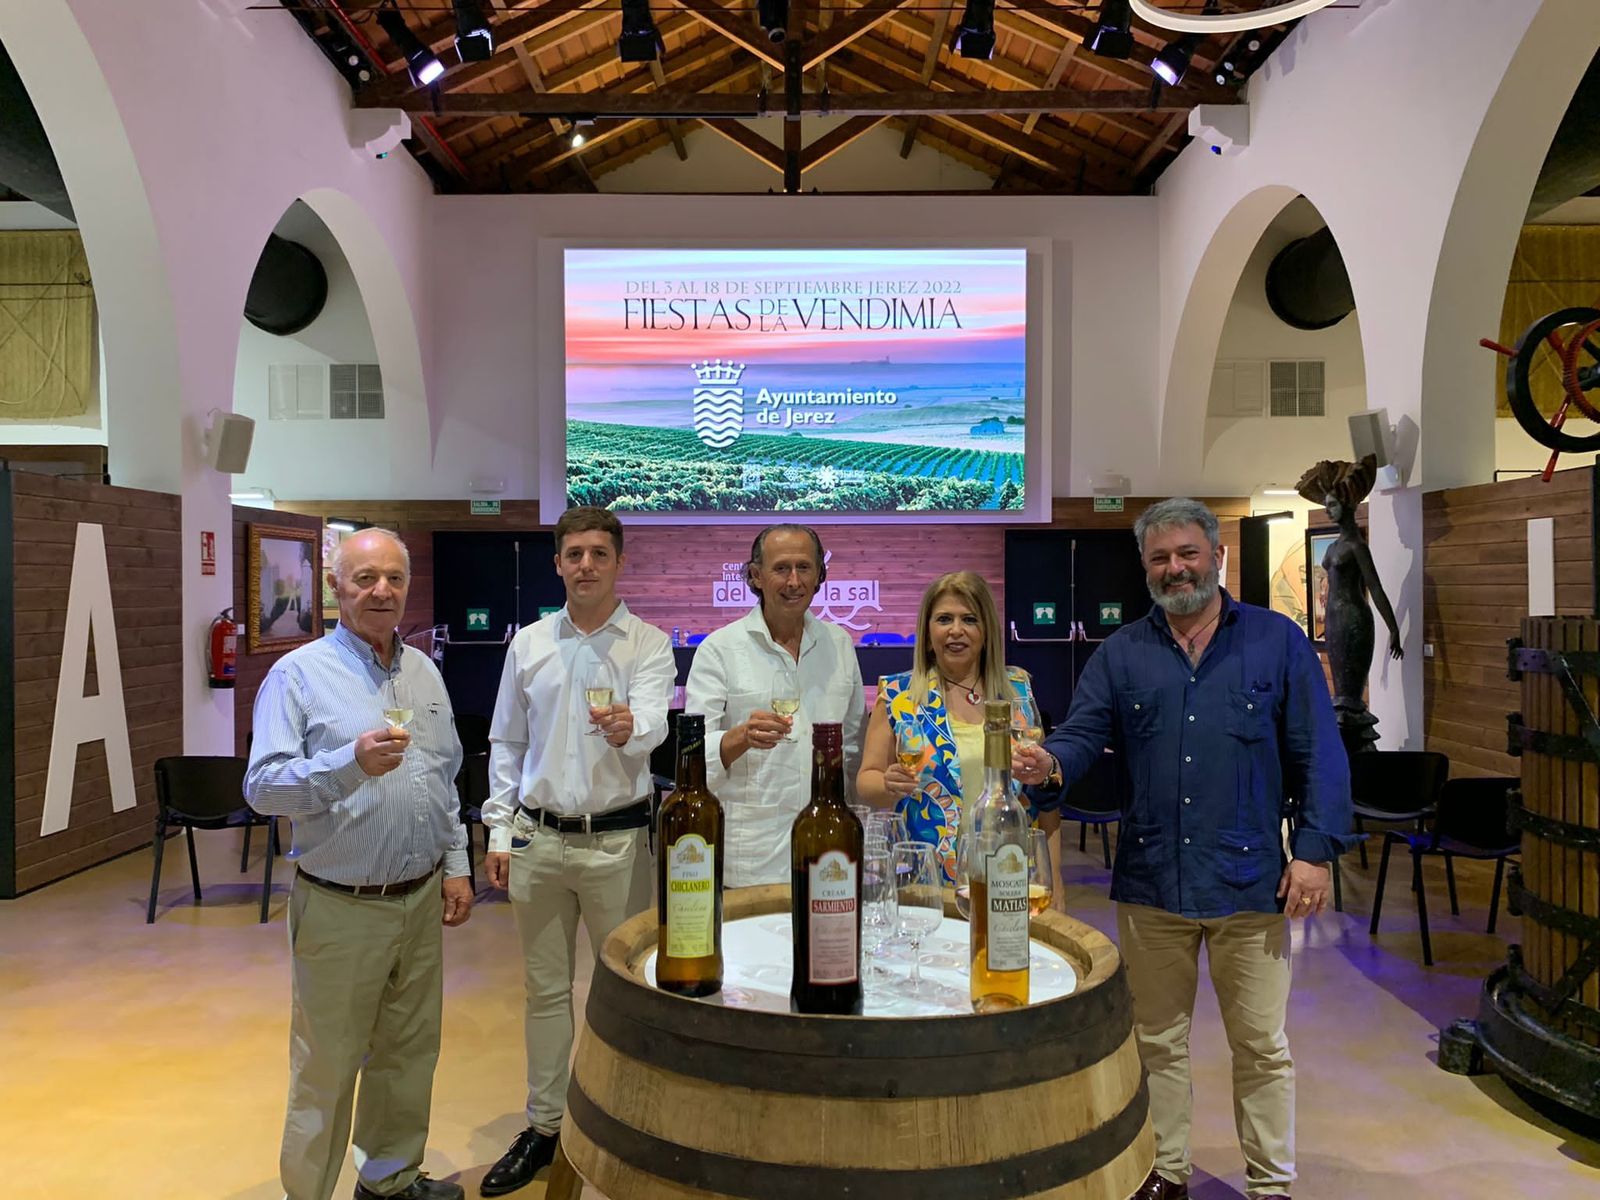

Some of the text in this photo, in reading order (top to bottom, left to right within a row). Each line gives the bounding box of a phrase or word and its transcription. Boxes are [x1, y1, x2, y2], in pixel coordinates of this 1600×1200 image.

[626, 281, 659, 294] DEL
[677, 281, 699, 294] AL
[705, 281, 719, 294] 18
[726, 281, 749, 294] DE
[754, 281, 863, 295] SEPTIEMBRE
[867, 281, 919, 297] JEREZ
[923, 281, 962, 294] 2022
[624, 298, 963, 332] FIESTAS DE LA VENDIMIA
[756, 387, 897, 408] Ayuntamiento
[756, 407, 836, 428] de Jerez
[716, 581, 875, 602] del la sal
[822, 889, 847, 897] CREAM
[813, 900, 854, 912] SARMIENTO
[993, 898, 1027, 911] MATIAS
